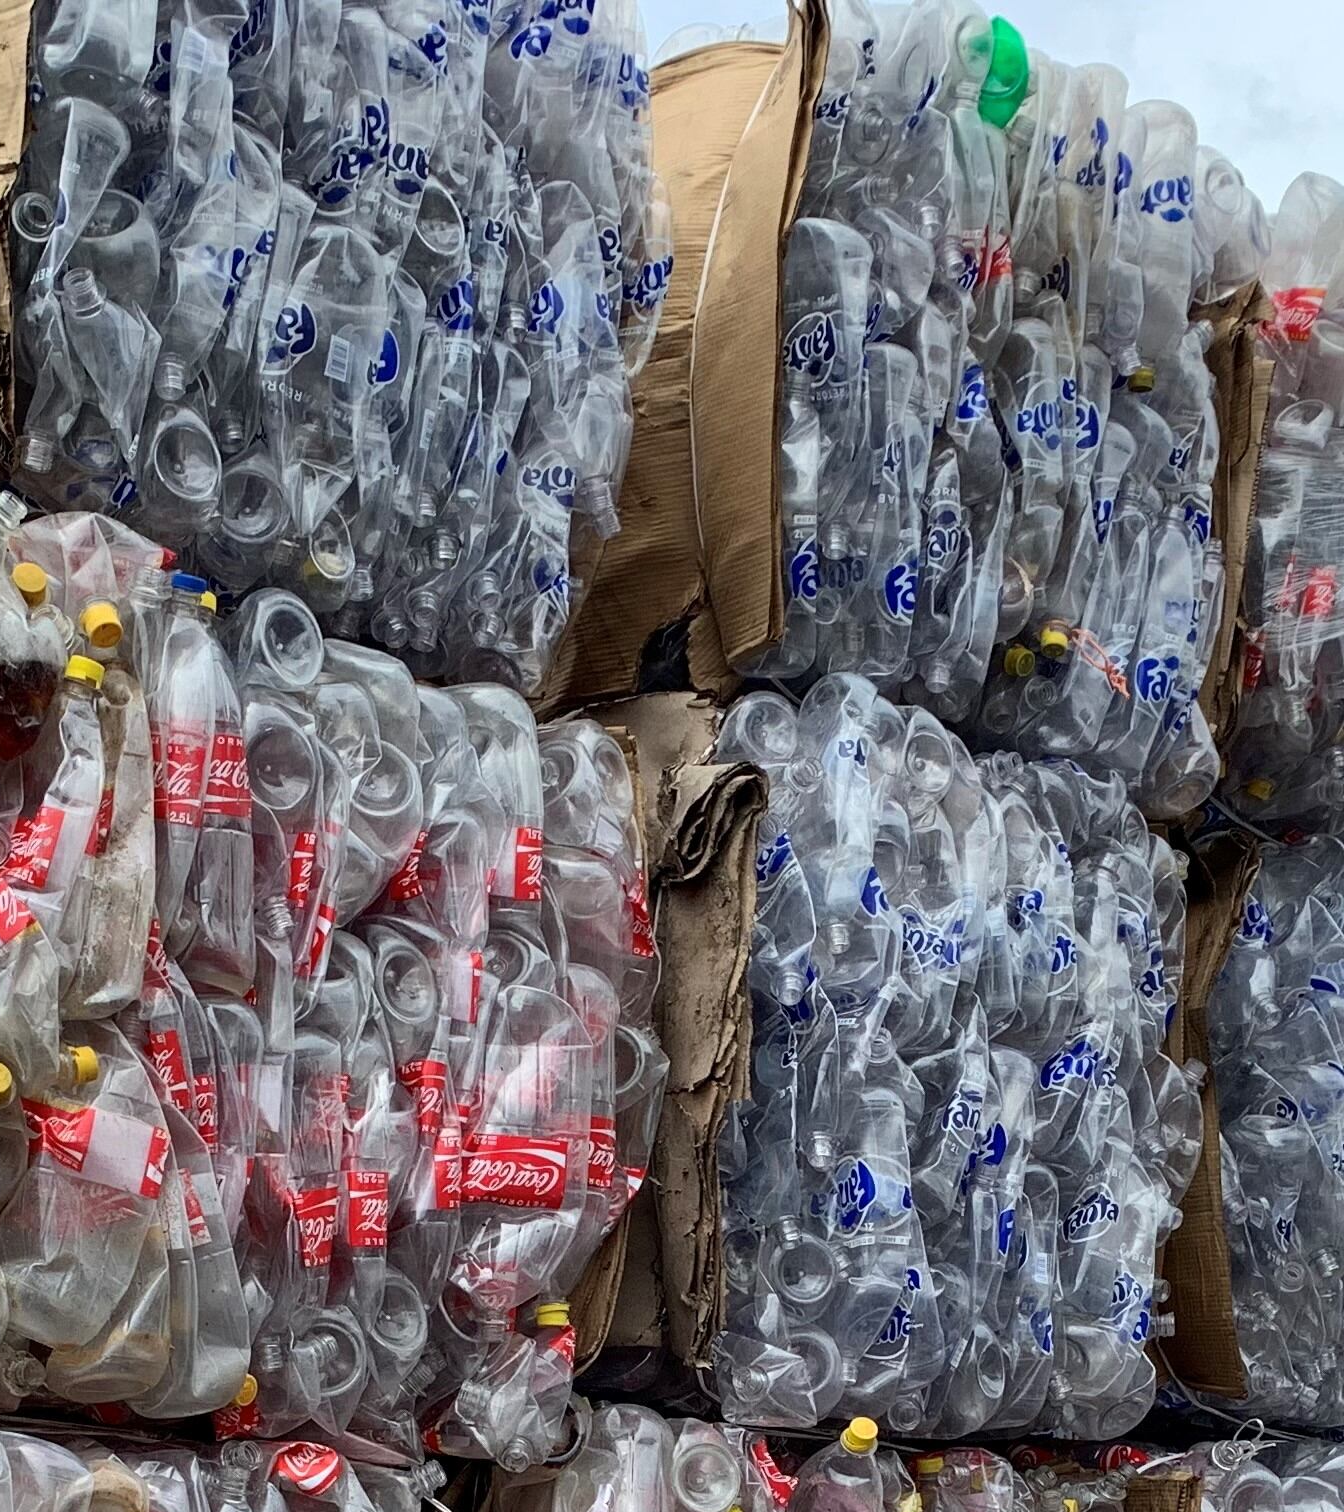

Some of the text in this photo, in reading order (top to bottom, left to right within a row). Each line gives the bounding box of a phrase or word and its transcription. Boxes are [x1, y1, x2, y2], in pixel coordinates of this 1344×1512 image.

[171, 811, 192, 823] 2.5L
[468, 1160, 559, 1195] Coca-Cola
[1063, 1192, 1119, 1231] Fanta
